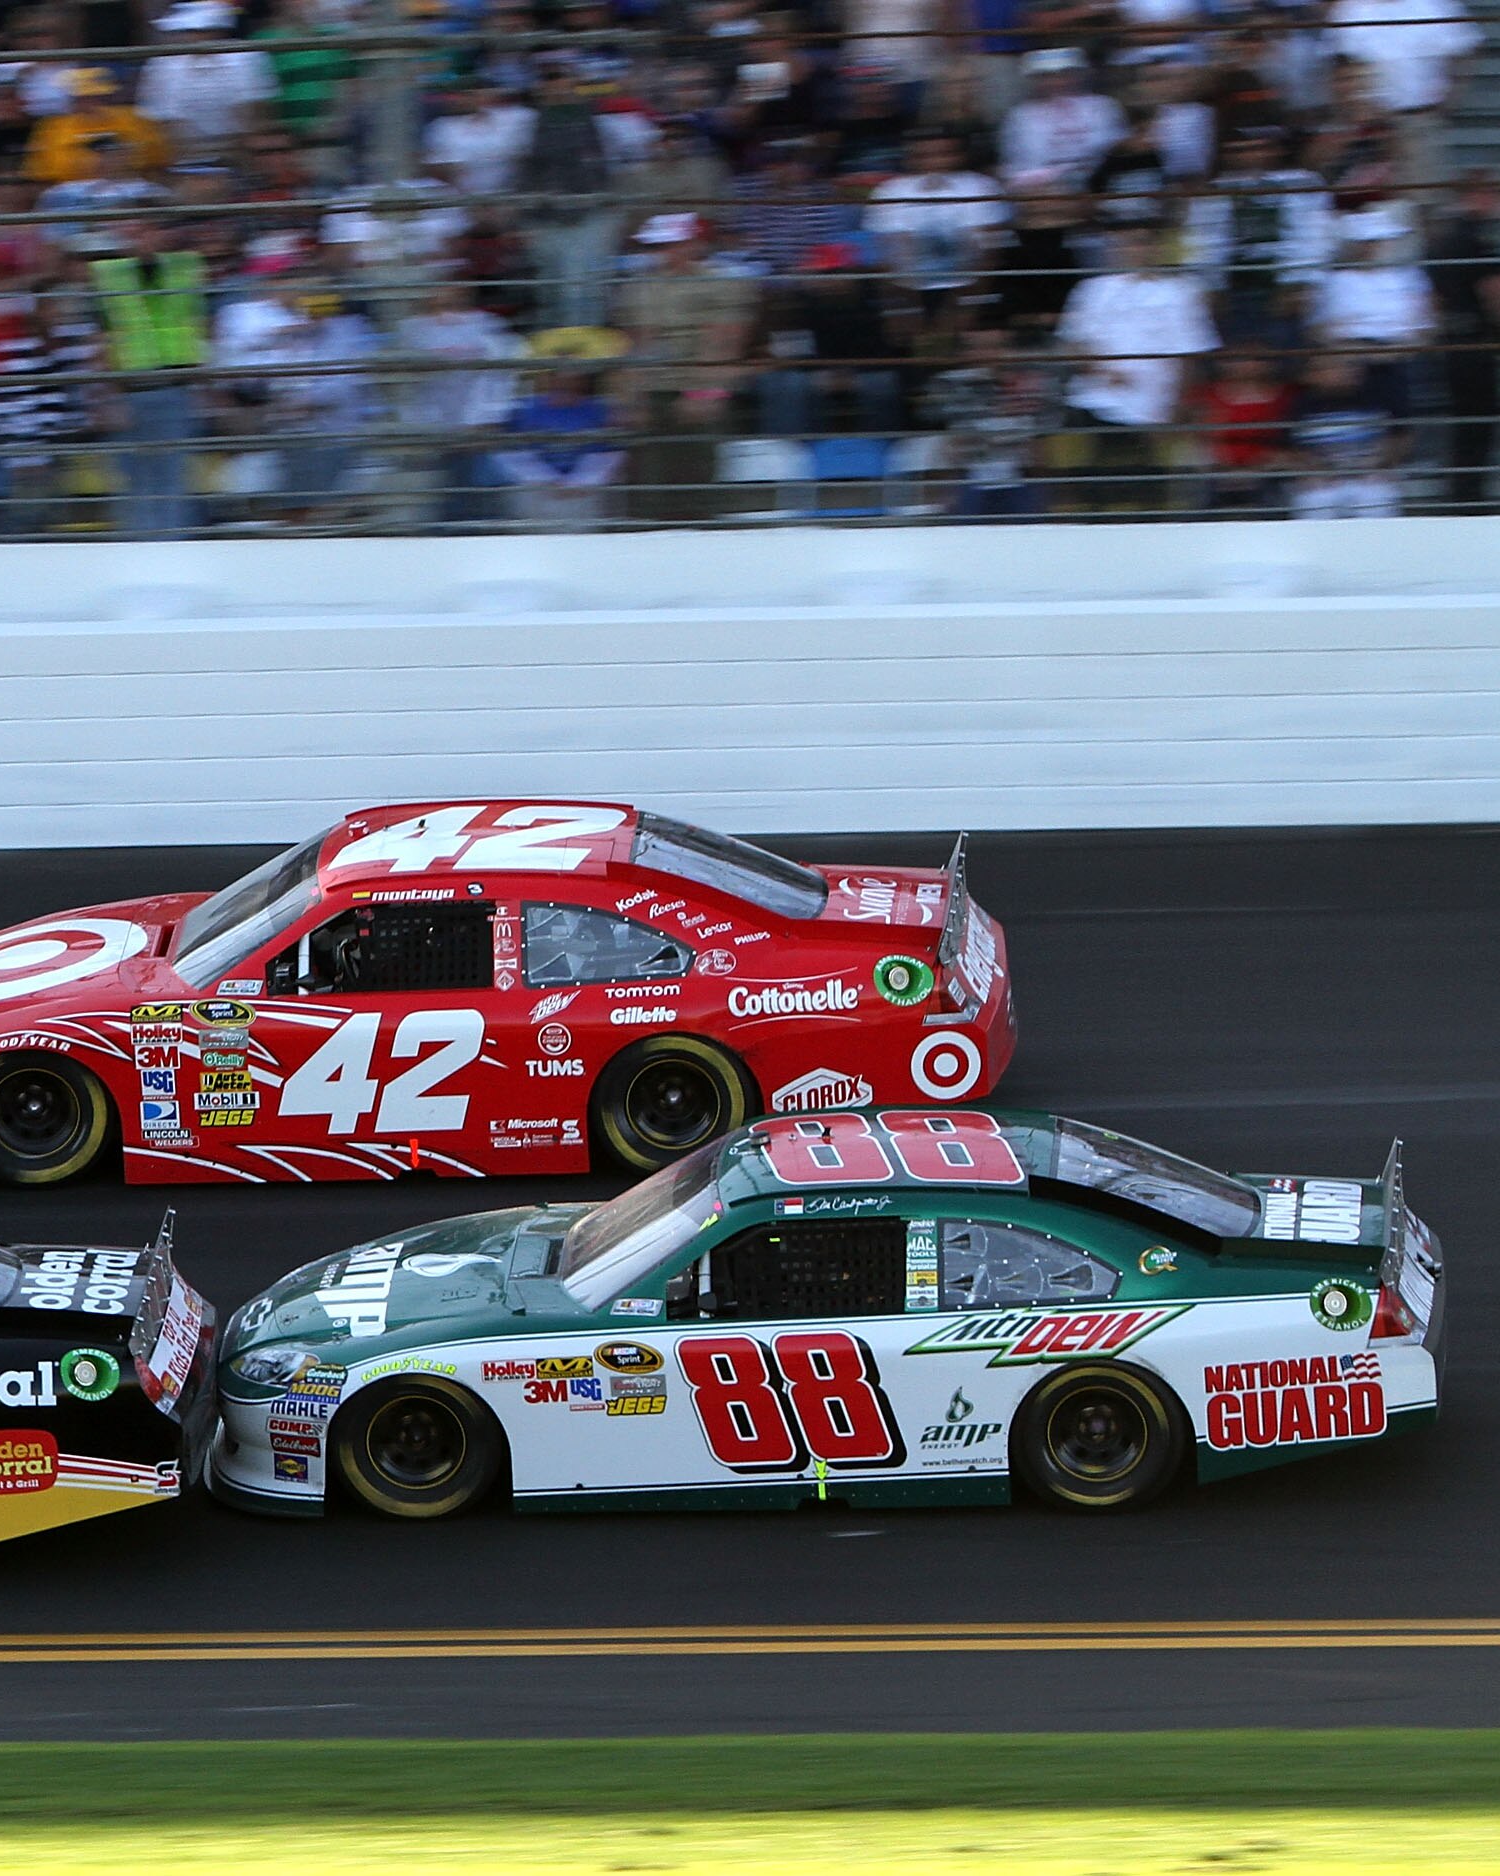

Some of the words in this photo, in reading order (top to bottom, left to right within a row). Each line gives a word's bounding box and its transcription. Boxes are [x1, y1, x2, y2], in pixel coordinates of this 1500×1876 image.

[326, 805, 628, 873] 42
[371, 888, 455, 902] montoya
[468, 883, 483, 895] 3
[615, 889, 659, 913] Kodak
[843, 877, 897, 925] Suave
[697, 921, 733, 940] Lexar
[734, 931, 771, 946] PHILIPS
[876, 954, 925, 972] AMERICAN
[728, 978, 859, 1017] Cottonelle
[883, 985, 933, 1007] ETHANOL
[211, 1010, 234, 1018] Sprint
[610, 1006, 677, 1025] Gillette
[132, 1025, 181, 1042] Holley
[137, 1046, 179, 1068] 3M
[203, 1051, 245, 1067] O'Reilly
[216, 1073, 244, 1081] Auto
[278, 1008, 485, 1135] 42
[525, 1059, 584, 1077] TUMS
[142, 1070, 173, 1093] USG
[214, 1081, 250, 1090] Meter
[198, 1094, 238, 1106] Mobil
[201, 1110, 255, 1126] JEGS
[507, 1118, 559, 1130] Microsoft
[145, 1130, 189, 1139] LINCOLN
[154, 1138, 194, 1147] WELDERS
[749, 1110, 1026, 1185] 88
[1299, 1180, 1363, 1245] UARD
[907, 1236, 937, 1251] MAC
[81, 1248, 141, 1314] corral
[1312, 1277, 1365, 1298] AMERICAN
[1314, 1311, 1367, 1331] ETHANOL
[162, 1322, 178, 1346] TOP
[176, 1331, 195, 1357] Eat
[72, 1348, 120, 1371] AMERICAN
[167, 1347, 190, 1383] Kids
[361, 1354, 457, 1381] GOODYEAR
[616, 1355, 641, 1365] Sprint
[484, 1362, 536, 1380] Holley
[1204, 1355, 1343, 1394] NATIONAL
[67, 1384, 114, 1401] ETHANOL
[291, 1382, 340, 1397] MOOG
[523, 1380, 569, 1404] 3M
[570, 1378, 602, 1401] USG
[271, 1399, 328, 1418] MAHLE
[608, 1397, 665, 1415] JEGS
[675, 1329, 902, 1470] 88
[1206, 1381, 1385, 1449] GUARD
[269, 1419, 312, 1433] COMP
[918, 1423, 1002, 1448] amp
[273, 1437, 319, 1452] Edelbrock
[6, 1480, 14, 1489] &
[15, 1479, 40, 1488] Grill
